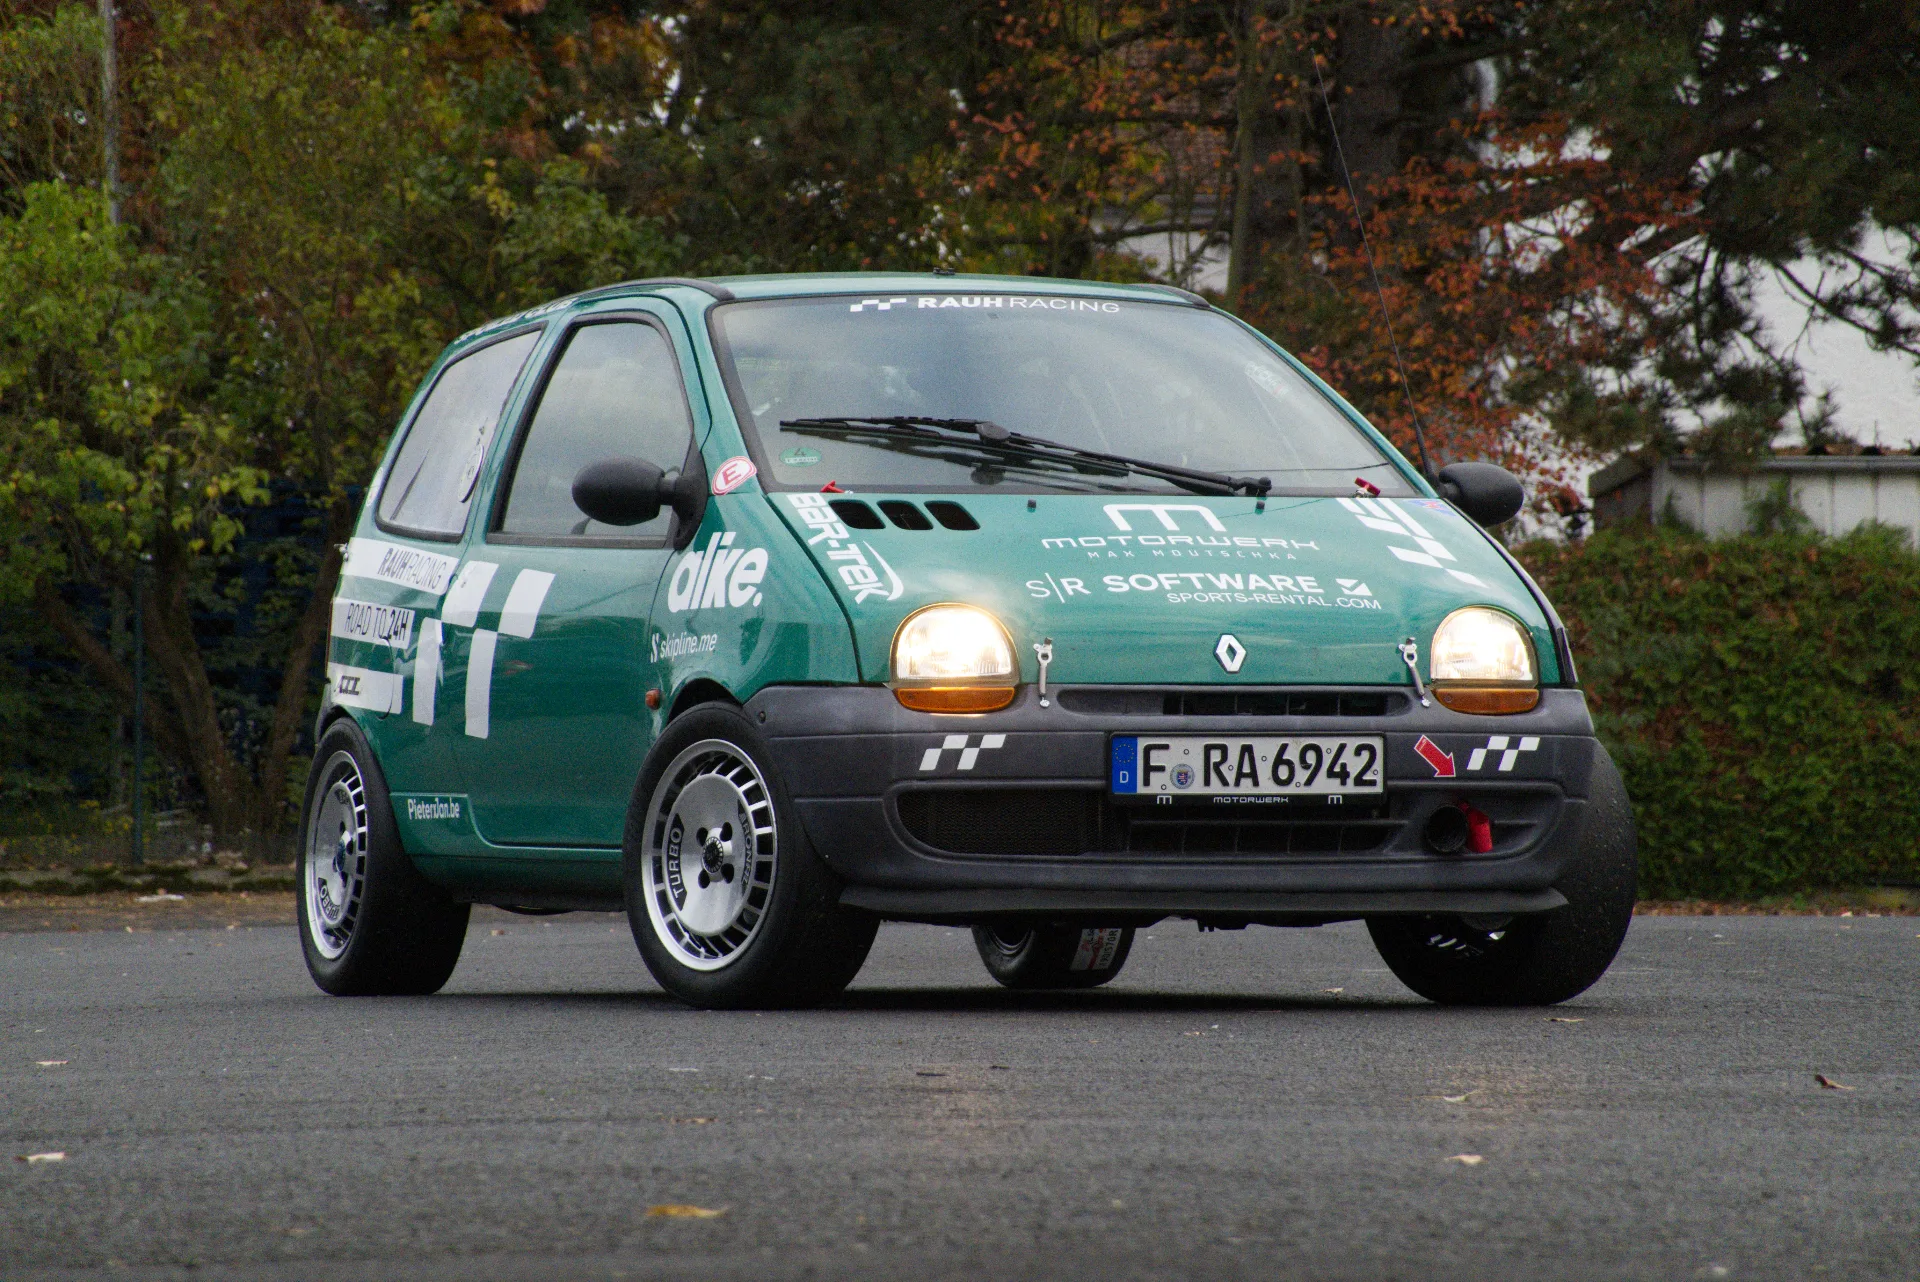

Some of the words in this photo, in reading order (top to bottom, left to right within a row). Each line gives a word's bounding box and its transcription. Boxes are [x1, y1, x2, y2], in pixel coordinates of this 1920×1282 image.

[722, 462, 742, 486] E
[1087, 551, 1136, 559] MAX
[1152, 549, 1297, 560] MOUTSCHKA
[667, 531, 769, 613] alike.
[1102, 572, 1325, 594] SOFTWARE
[1166, 592, 1382, 610] SPORTS-RENTAL.COM
[344, 602, 372, 636] ROAD
[660, 631, 718, 661] skipline.me
[1120, 770, 1129, 783] D
[1142, 743, 1170, 787] F
[1203, 743, 1260, 787] RA
[1271, 742, 1378, 787] 6942
[667, 826, 685, 900] TURBO
